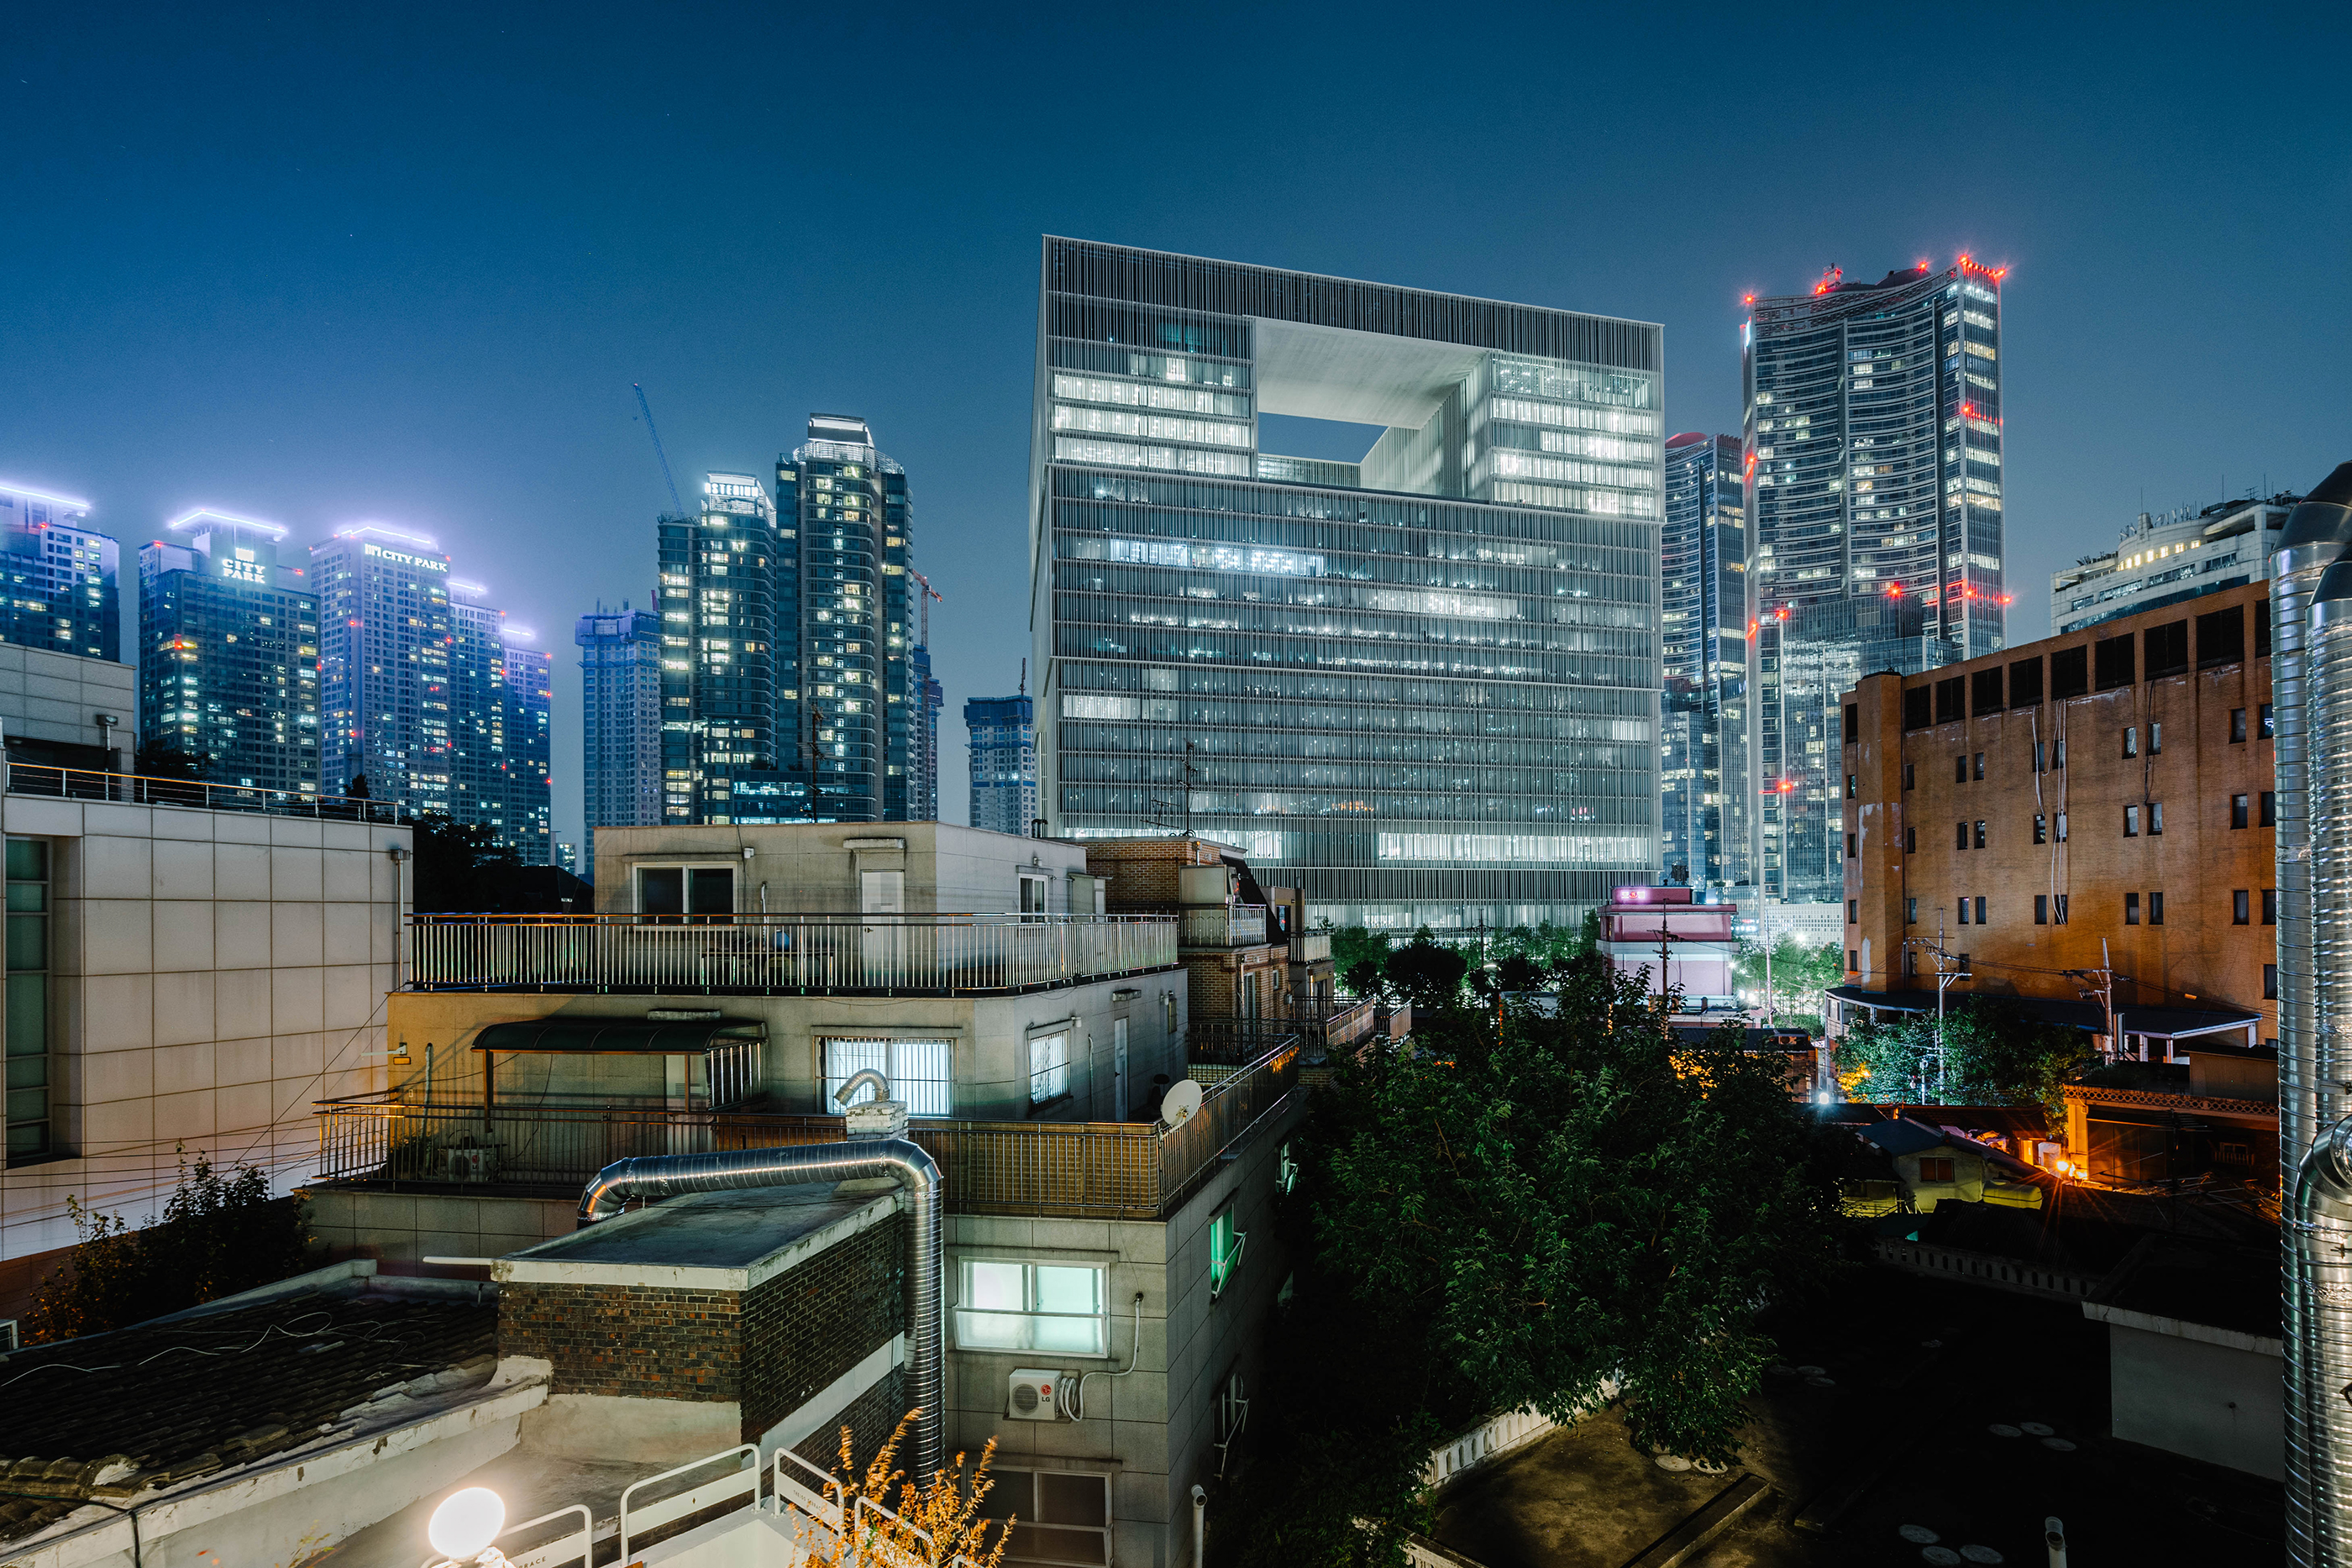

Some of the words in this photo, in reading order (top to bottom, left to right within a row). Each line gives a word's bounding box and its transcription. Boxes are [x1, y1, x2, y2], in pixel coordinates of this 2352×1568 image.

[222, 559, 265, 574] CITY
[382, 550, 413, 564] CITY
[414, 557, 448, 572] PARK
[223, 568, 265, 584] PARK
